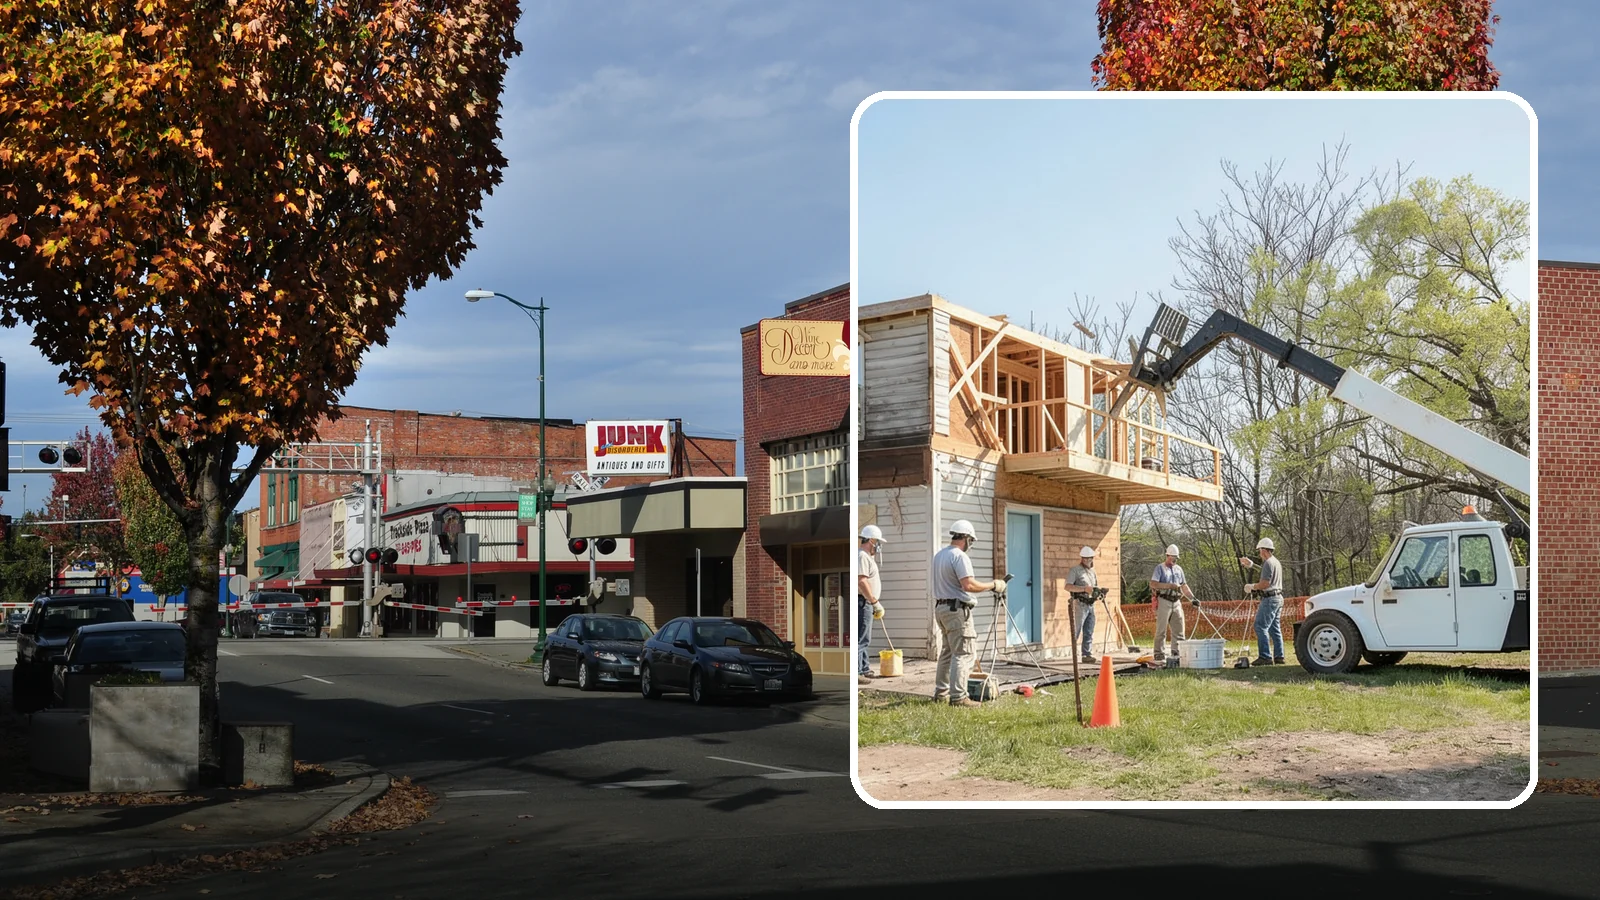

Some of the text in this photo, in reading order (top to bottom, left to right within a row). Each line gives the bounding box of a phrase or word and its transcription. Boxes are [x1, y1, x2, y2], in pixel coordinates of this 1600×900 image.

[595, 425, 664, 457] JUNK
[607, 446, 645, 454] DISORDERLY
[597, 460, 665, 470] ANTIQUES AND GIFTS
[573, 473, 589, 492] RAIL
[590, 476, 608, 491] SING
[414, 519, 429, 535] Pizza
